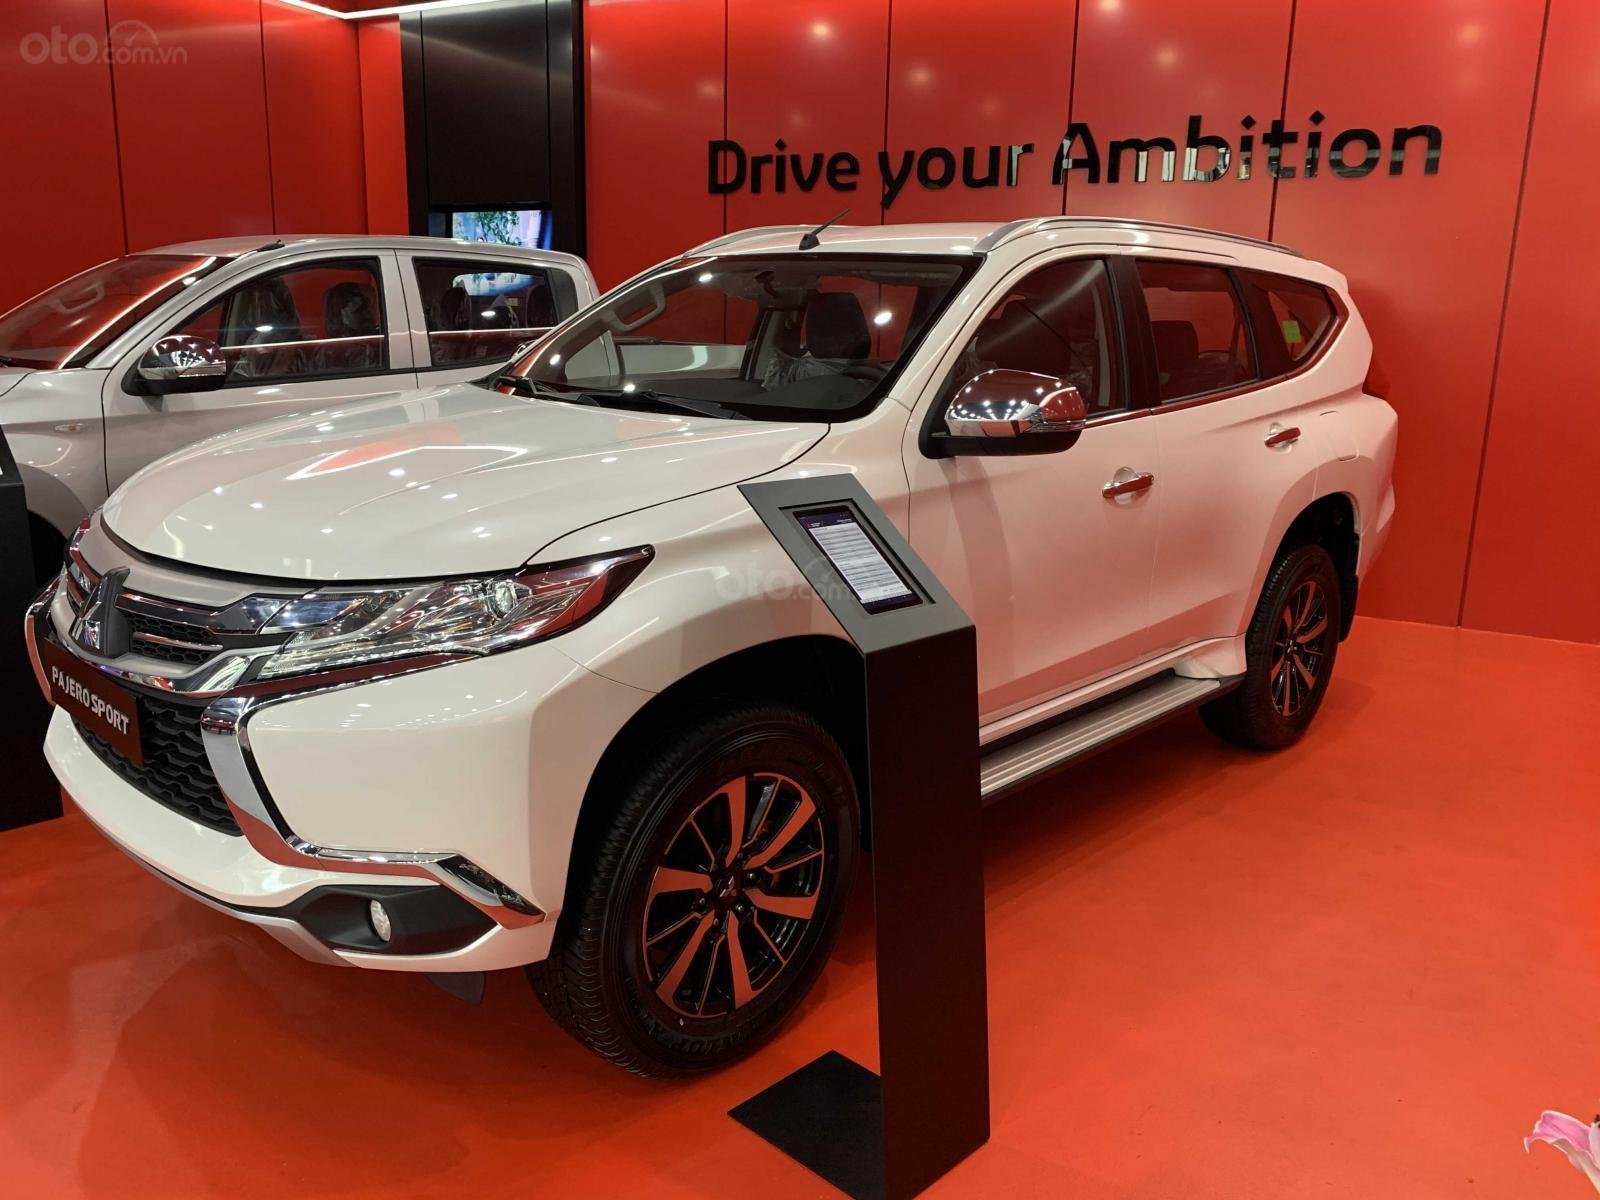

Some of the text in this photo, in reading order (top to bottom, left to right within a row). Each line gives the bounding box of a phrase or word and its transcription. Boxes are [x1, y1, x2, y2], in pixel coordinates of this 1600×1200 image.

[708, 110, 1442, 209] Drive your Ambition
[52, 666, 129, 734] PAJERO SPORT
